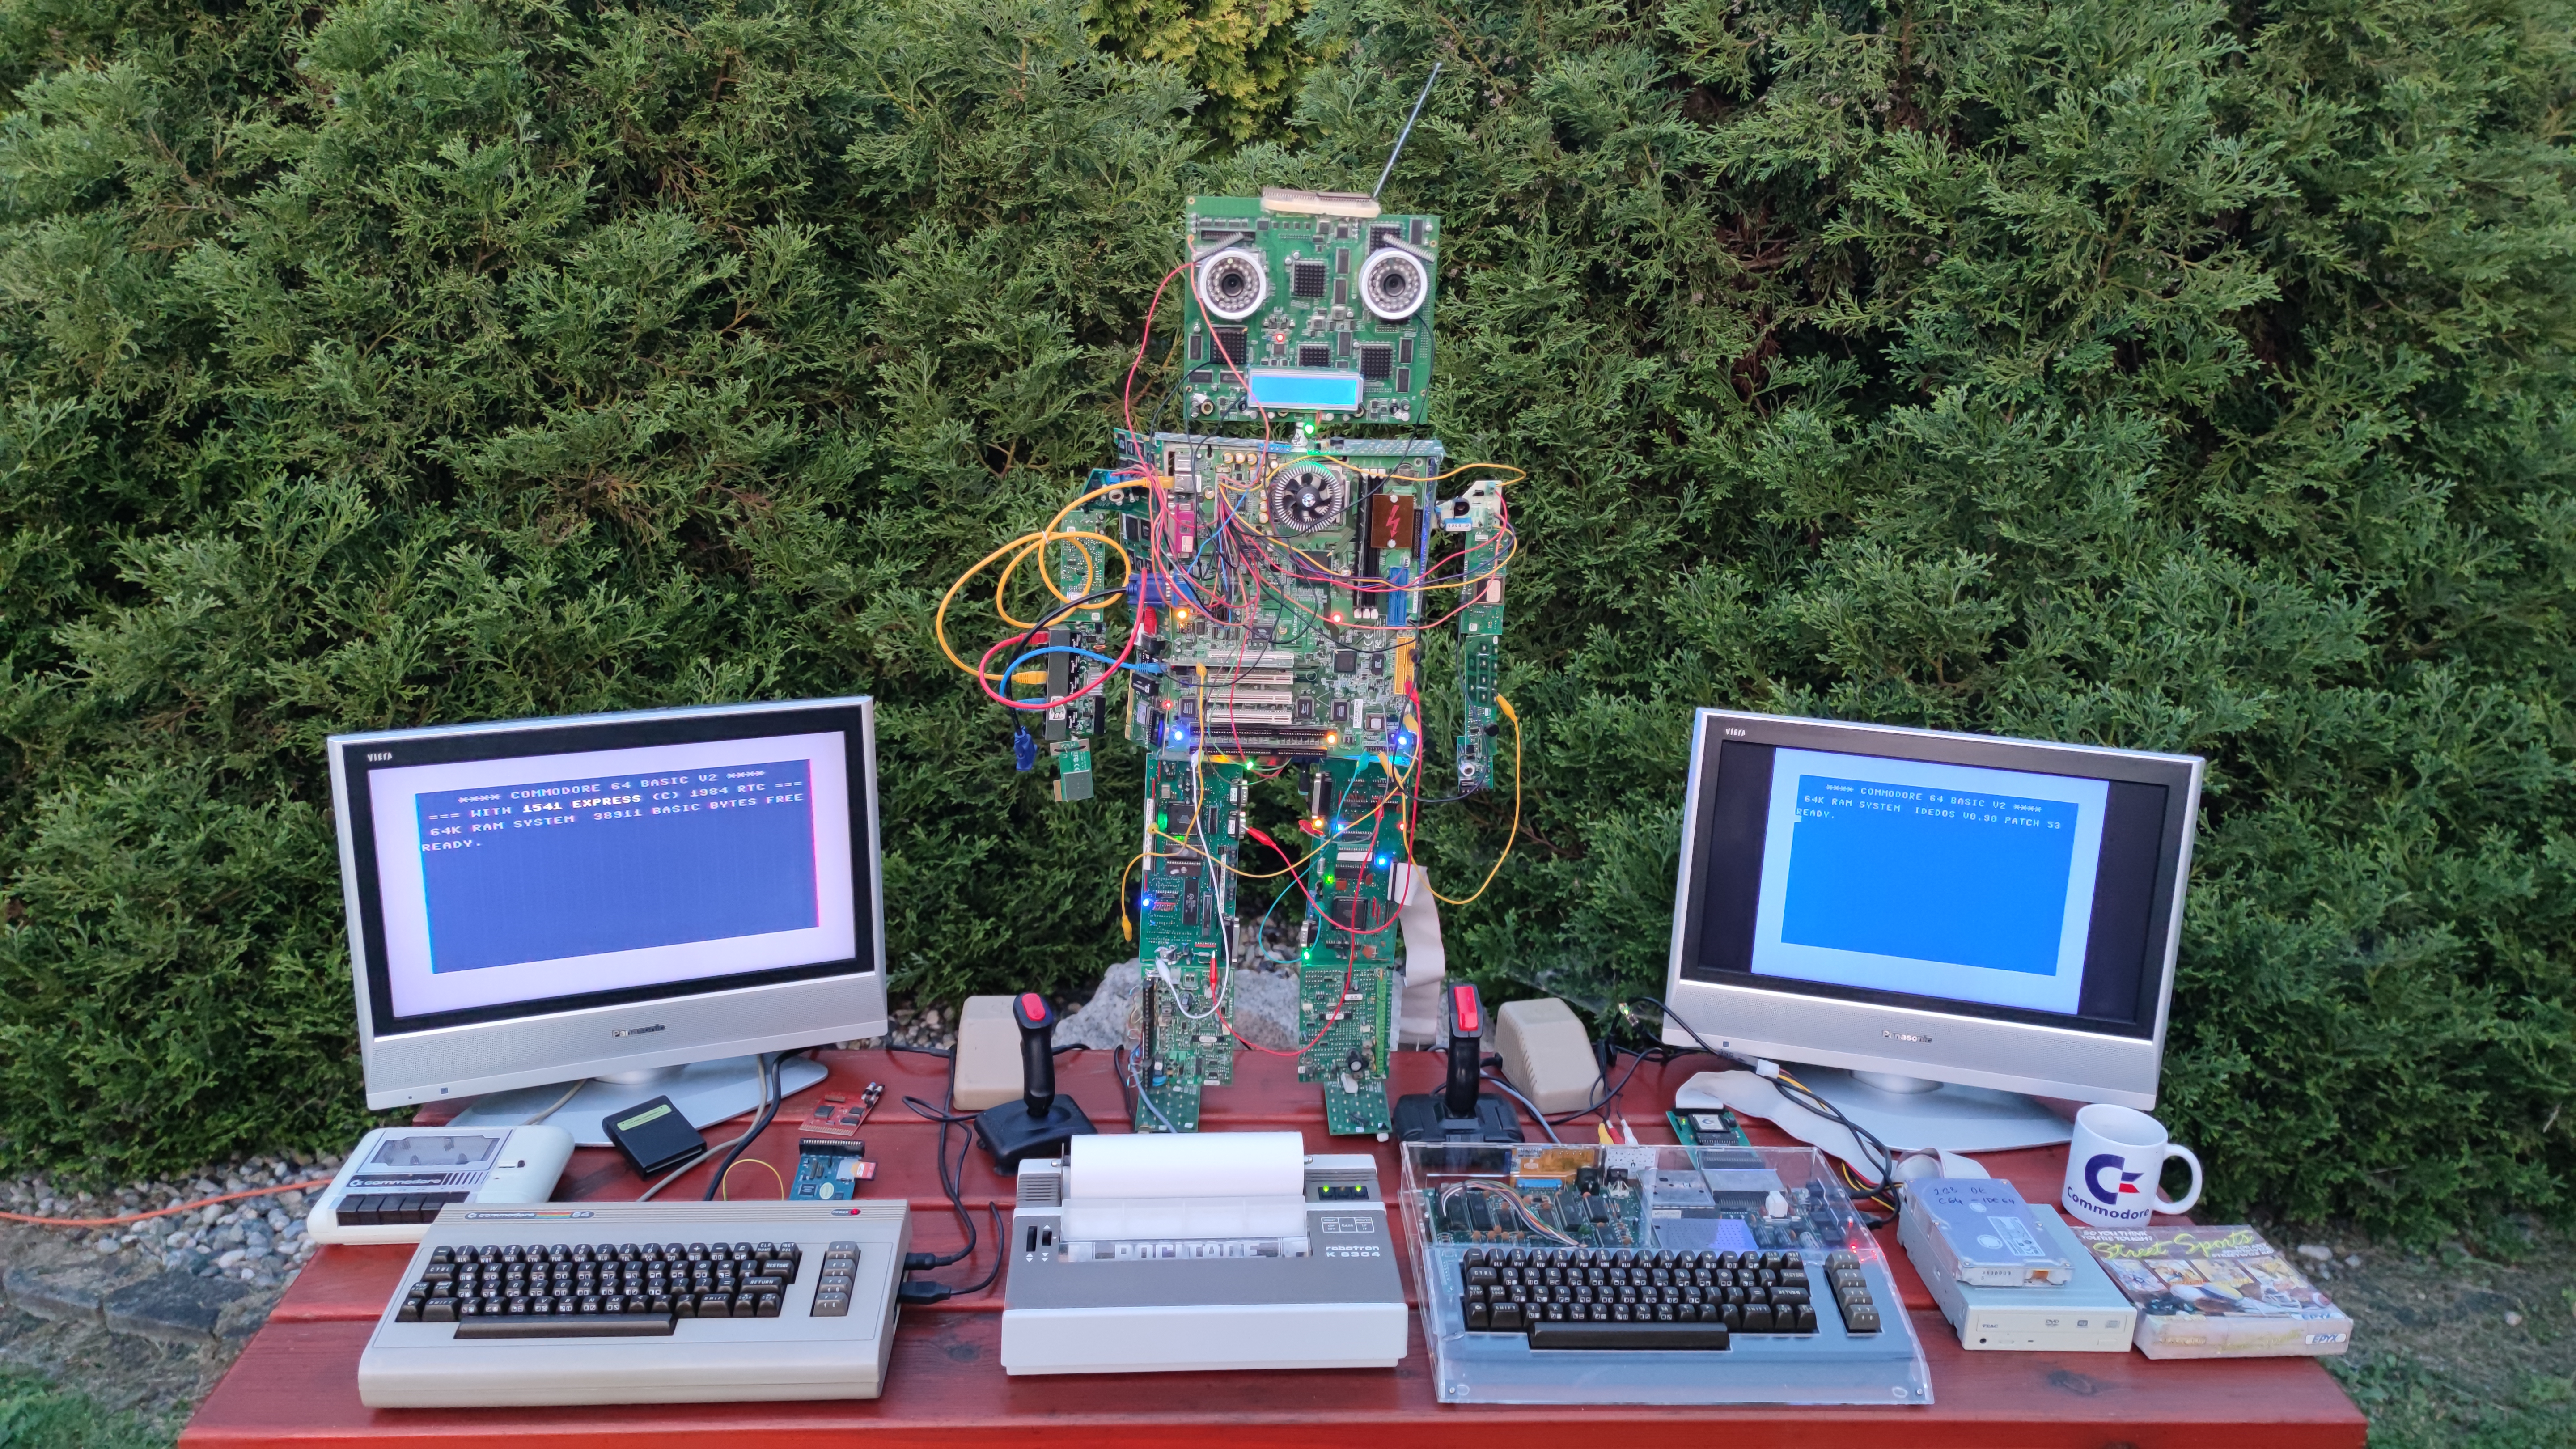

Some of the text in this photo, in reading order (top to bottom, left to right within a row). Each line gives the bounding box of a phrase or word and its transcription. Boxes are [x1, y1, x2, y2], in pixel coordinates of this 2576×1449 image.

[1725, 728, 1746, 737] VIERA
[367, 752, 392, 762] VIERA
[510, 784, 602, 799] COMMODORE
[611, 781, 631, 790] 64
[640, 776, 688, 788] BASIC
[698, 774, 719, 782] V2
[1860, 787, 1923, 801] COMMODORE
[1930, 794, 1944, 803] 64
[1951, 797, 1985, 807] BASIC
[1993, 801, 2006, 809] V2
[470, 806, 512, 818] WITH
[522, 801, 564, 813] 1541
[572, 794, 641, 809] EXPRESS
[652, 791, 679, 801] (C)
[690, 786, 729, 797] 1984
[737, 783, 766, 793] RTC
[1804, 795, 1825, 804] 64K
[1831, 797, 1852, 807] RAM
[1859, 801, 1901, 812] SYSTEM
[1915, 806, 1955, 818] IDEDOS
[1963, 811, 1997, 822] V0.90
[2004, 816, 2039, 827] PATCH
[430, 793, 804, 836] 64K RAM SYSTEM 38911 BASIC BYTES FREE
[1796, 807, 1834, 819] READY.
[422, 839, 482, 852] READY.
[1882, 1030, 1932, 1043] Panasonic
[2067, 1186, 2149, 1220] Commodore
[2093, 1230, 2254, 1259] Street Sports
